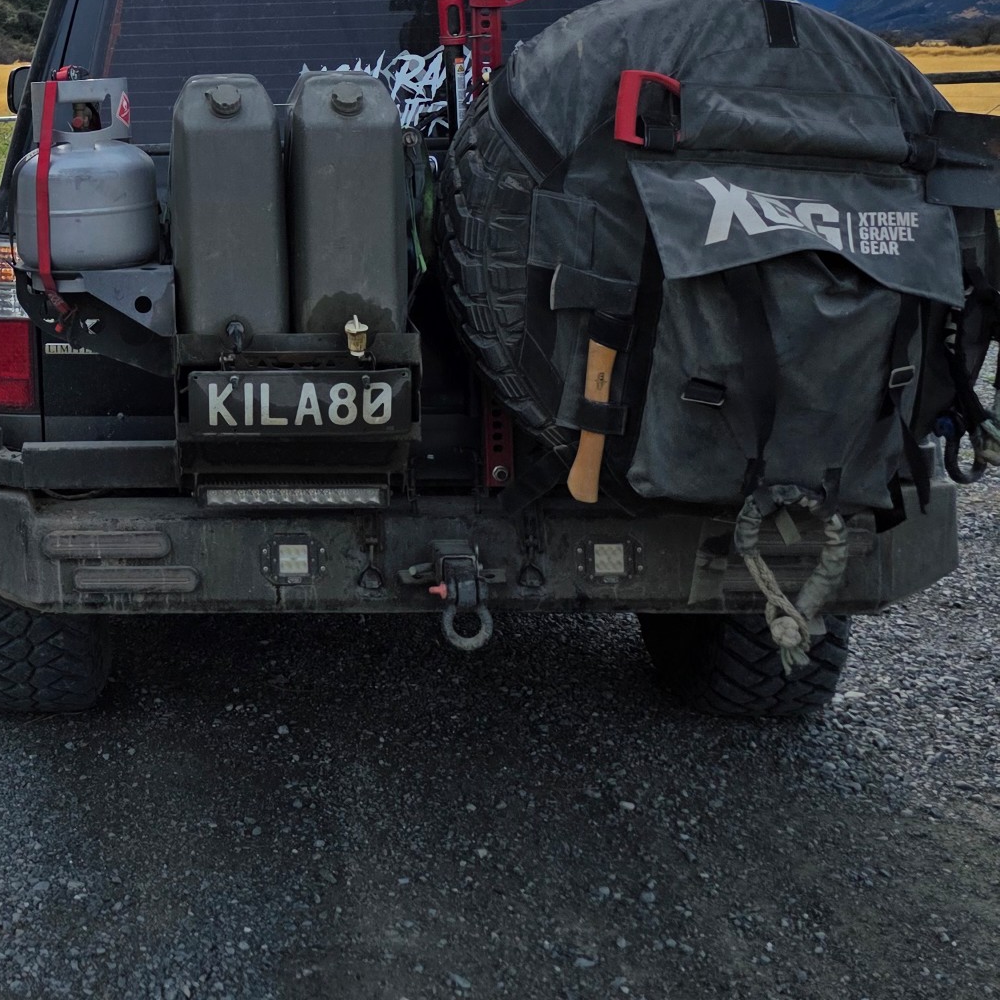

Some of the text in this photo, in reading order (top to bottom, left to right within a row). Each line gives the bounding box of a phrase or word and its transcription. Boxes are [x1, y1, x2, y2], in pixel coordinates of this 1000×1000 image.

[858, 211, 919, 228] XTREME
[859, 226, 915, 242] GRAVEL
[860, 240, 900, 256] GEAR
[208, 382, 393, 427] KILA80
